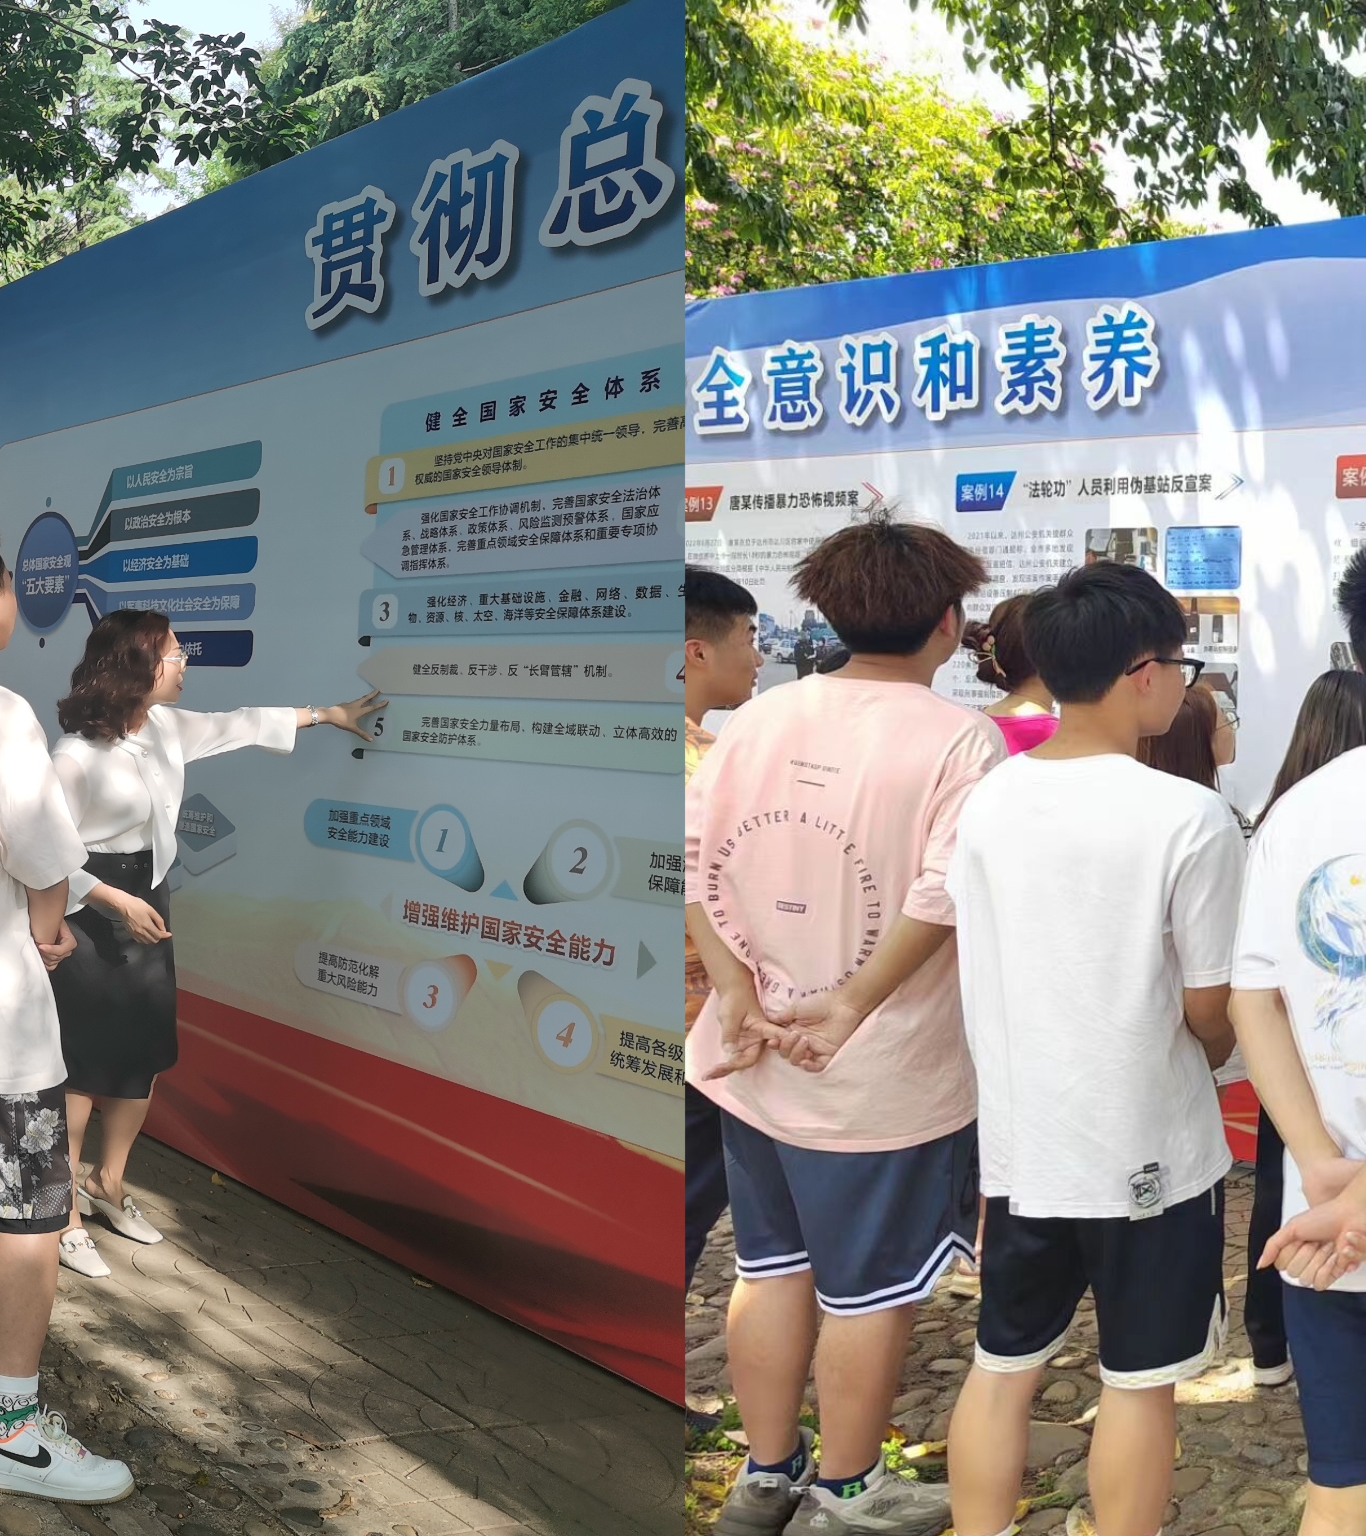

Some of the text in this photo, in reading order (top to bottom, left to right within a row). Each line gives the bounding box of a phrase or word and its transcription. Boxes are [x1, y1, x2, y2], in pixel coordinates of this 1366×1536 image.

[308, 85, 669, 325] 贯彻总
[695, 306, 1157, 431] 全意识和素养
[425, 367, 661, 432] 健全国家安全体系
[126, 464, 194, 489] 以人民安全为宗旨
[388, 466, 395, 487] 1
[415, 459, 528, 486] 权威的国家安全领导体制。
[960, 482, 1004, 502] 案例14
[1023, 473, 1213, 499] “法轮功”人员利用伪基站反宣案
[729, 489, 859, 511] 唐某传播暴力恐怖视频案
[124, 509, 191, 531] 以政治安全为根本
[22, 554, 72, 572] 总体国家安全观
[122, 553, 190, 573] 以经济安全为基础
[401, 556, 451, 573] 调指挥体系。
[22, 575, 70, 595] “五大要素”
[379, 601, 390, 622] 3
[408, 605, 632, 624] 物、资源、核、太空、海洋等安全保障体系建设。
[374, 717, 385, 737] 5
[402, 730, 482, 748] 国家安全防护体系。
[328, 809, 391, 831] 加强重点领域
[800, 811, 807, 824] A
[327, 826, 390, 849] 安全能力建设
[435, 828, 448, 854] 1
[814, 815, 856, 855] LITTE
[717, 837, 736, 858] US
[569, 846, 589, 875] 2
[707, 861, 723, 902] BURN
[853, 858, 878, 894] FIRE
[713, 909, 728, 928] TO
[866, 901, 881, 919] TO
[402, 899, 616, 968] 增强维护国家安全能力
[318, 951, 380, 981] 提高防范化解
[317, 968, 378, 999] 重大风险能力
[422, 985, 439, 1009] 3
[556, 1022, 576, 1049] 4
